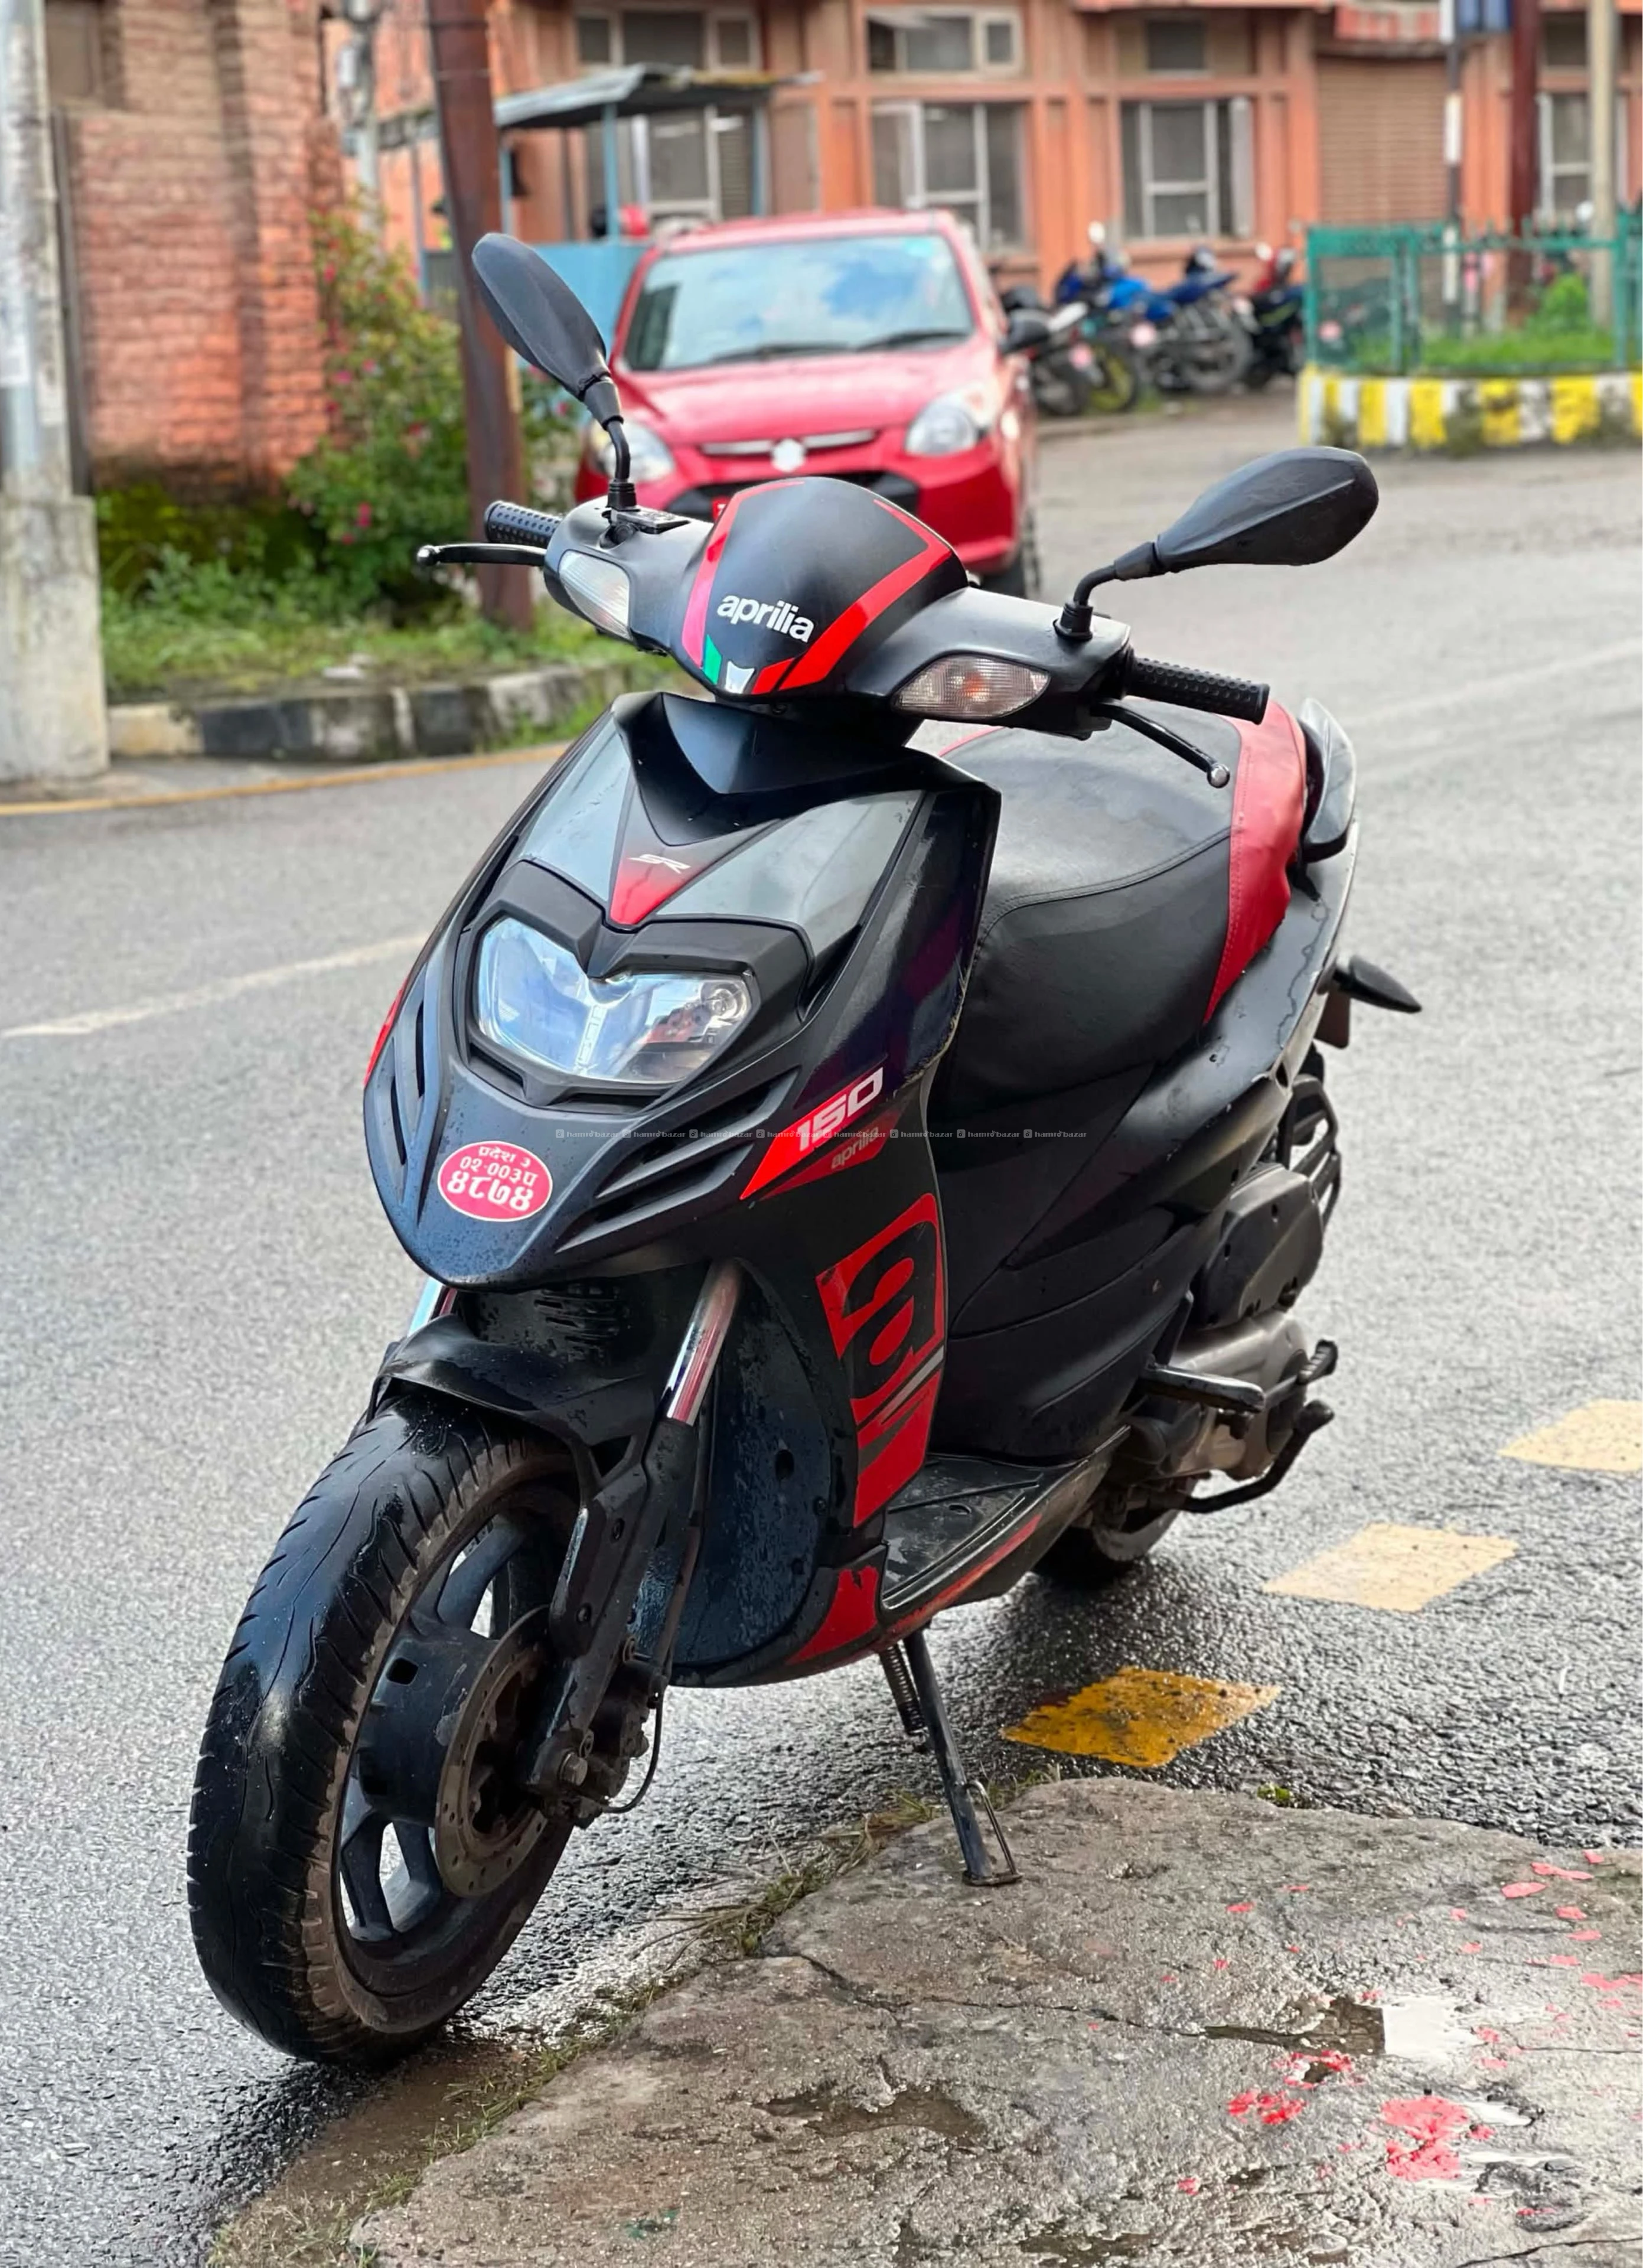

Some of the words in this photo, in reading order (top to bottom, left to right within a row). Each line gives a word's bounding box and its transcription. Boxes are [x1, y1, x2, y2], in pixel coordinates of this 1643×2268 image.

[716, 594, 815, 643] aprilia
[628, 853, 692, 874] SR
[797, 1067, 884, 1152] 150
[478, 1146, 517, 1163] प्रदेश
[830, 1126, 879, 1170] aprilia
[446, 1170, 534, 1211] ४८७४
